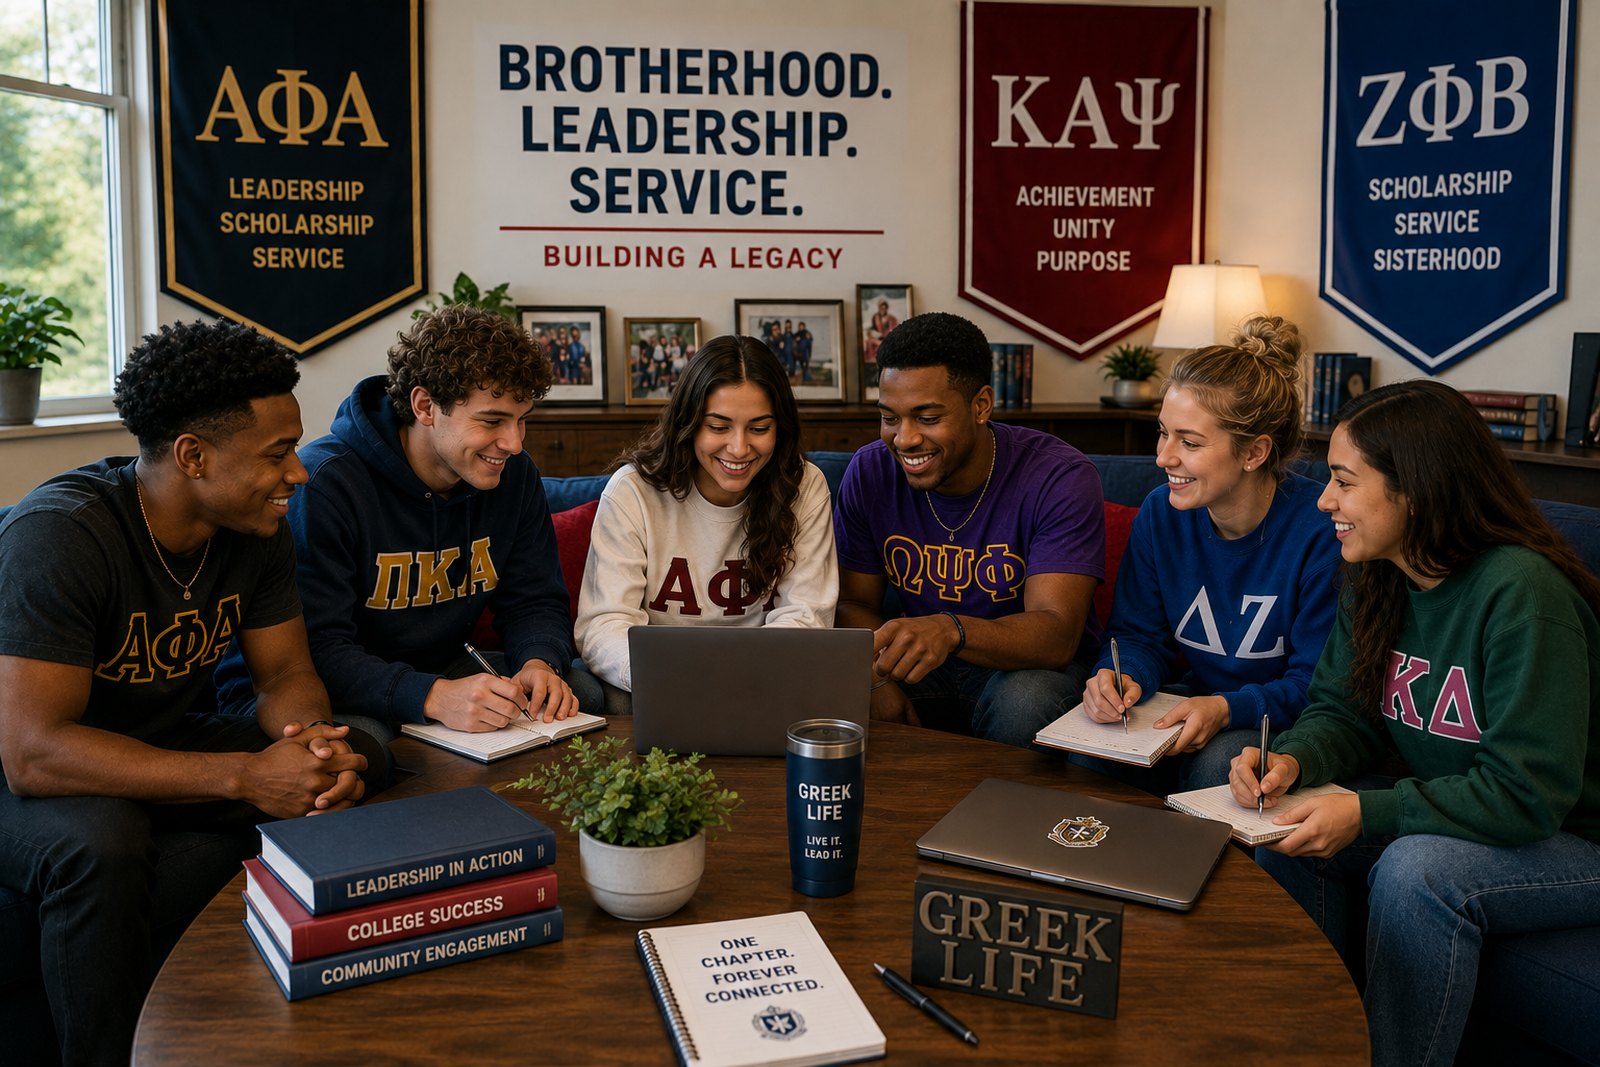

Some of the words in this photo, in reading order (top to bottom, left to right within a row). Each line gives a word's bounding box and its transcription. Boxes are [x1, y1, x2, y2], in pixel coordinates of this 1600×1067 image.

[499, 44, 892, 99] BROTHERHOOD.
[522, 105, 857, 157] LEADERSHIP.
[229, 177, 365, 201] LEADERSHIP
[569, 166, 803, 216] SERVICE.
[1016, 185, 1155, 207] ACHIEVEMENT
[1368, 169, 1513, 201] SCHOLARSHIP
[220, 211, 374, 235] SCHOLARSHIP
[1053, 218, 1115, 239] UNITY
[1394, 209, 1480, 235] SERVICE
[253, 246, 345, 269] SERVICE
[543, 245, 685, 268] BUILDING
[699, 247, 717, 268] A
[730, 246, 844, 269] LEGACY
[1037, 250, 1131, 271] PURPOSE
[1373, 246, 1501, 271] SISTERHOOD
[798, 783, 852, 802] GREEK
[807, 804, 842, 821] LIFE
[806, 835, 828, 846] LIVE
[831, 836, 842, 846] IT.
[805, 848, 830, 859] LEAD
[832, 849, 844, 859] IT.
[347, 863, 444, 898] LEADERSHIP
[449, 859, 464, 877] IN
[469, 848, 523, 873] ACTION
[347, 911, 425, 941] COLLEGE
[430, 896, 504, 925] SUCCESS
[919, 890, 1112, 963] GREEK
[720, 936, 759, 950] ONE
[321, 949, 421, 985] COMMUNITY
[425, 926, 528, 962] ENGAGEMENT
[701, 948, 795, 968] CHAPTER.
[712, 964, 798, 985] FOREVER
[940, 939, 1083, 1007] LIFE
[705, 979, 824, 1003] CONNECTED.
